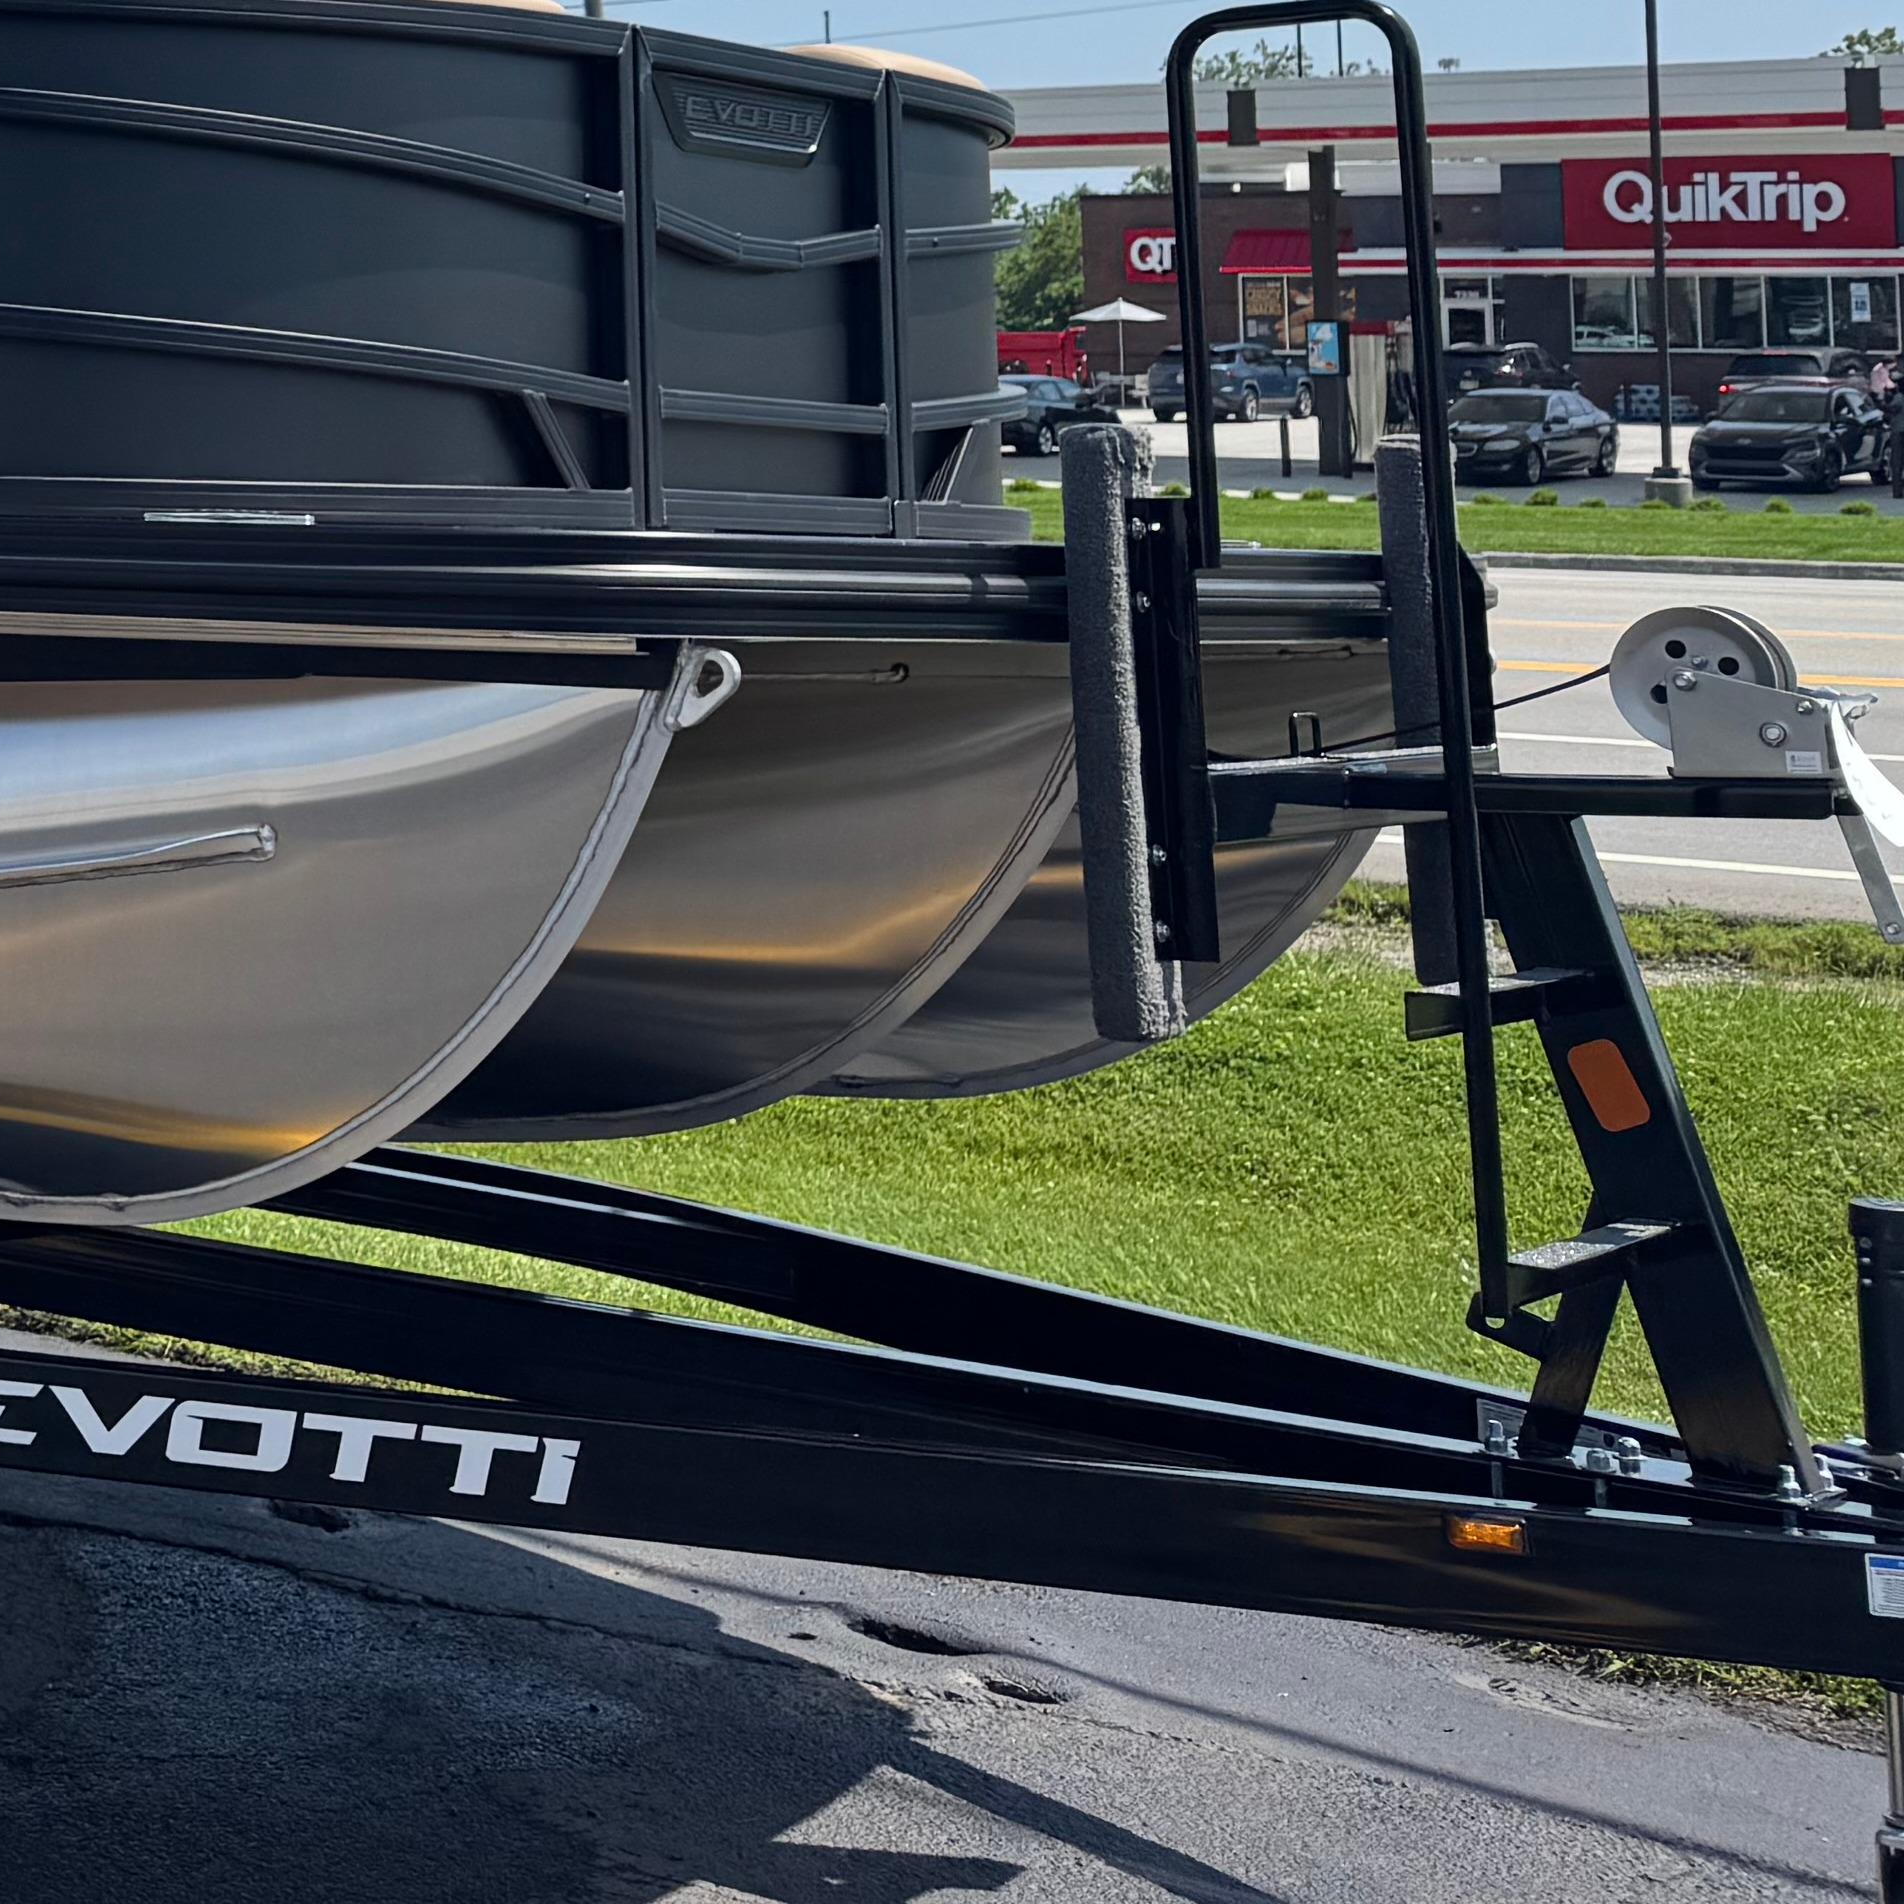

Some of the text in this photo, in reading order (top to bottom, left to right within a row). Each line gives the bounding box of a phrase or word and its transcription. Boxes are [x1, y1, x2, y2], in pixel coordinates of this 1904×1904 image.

[684, 96, 815, 137] EVOTTI
[1602, 169, 1847, 233] QuikTrip
[1129, 236, 1177, 274] QT
